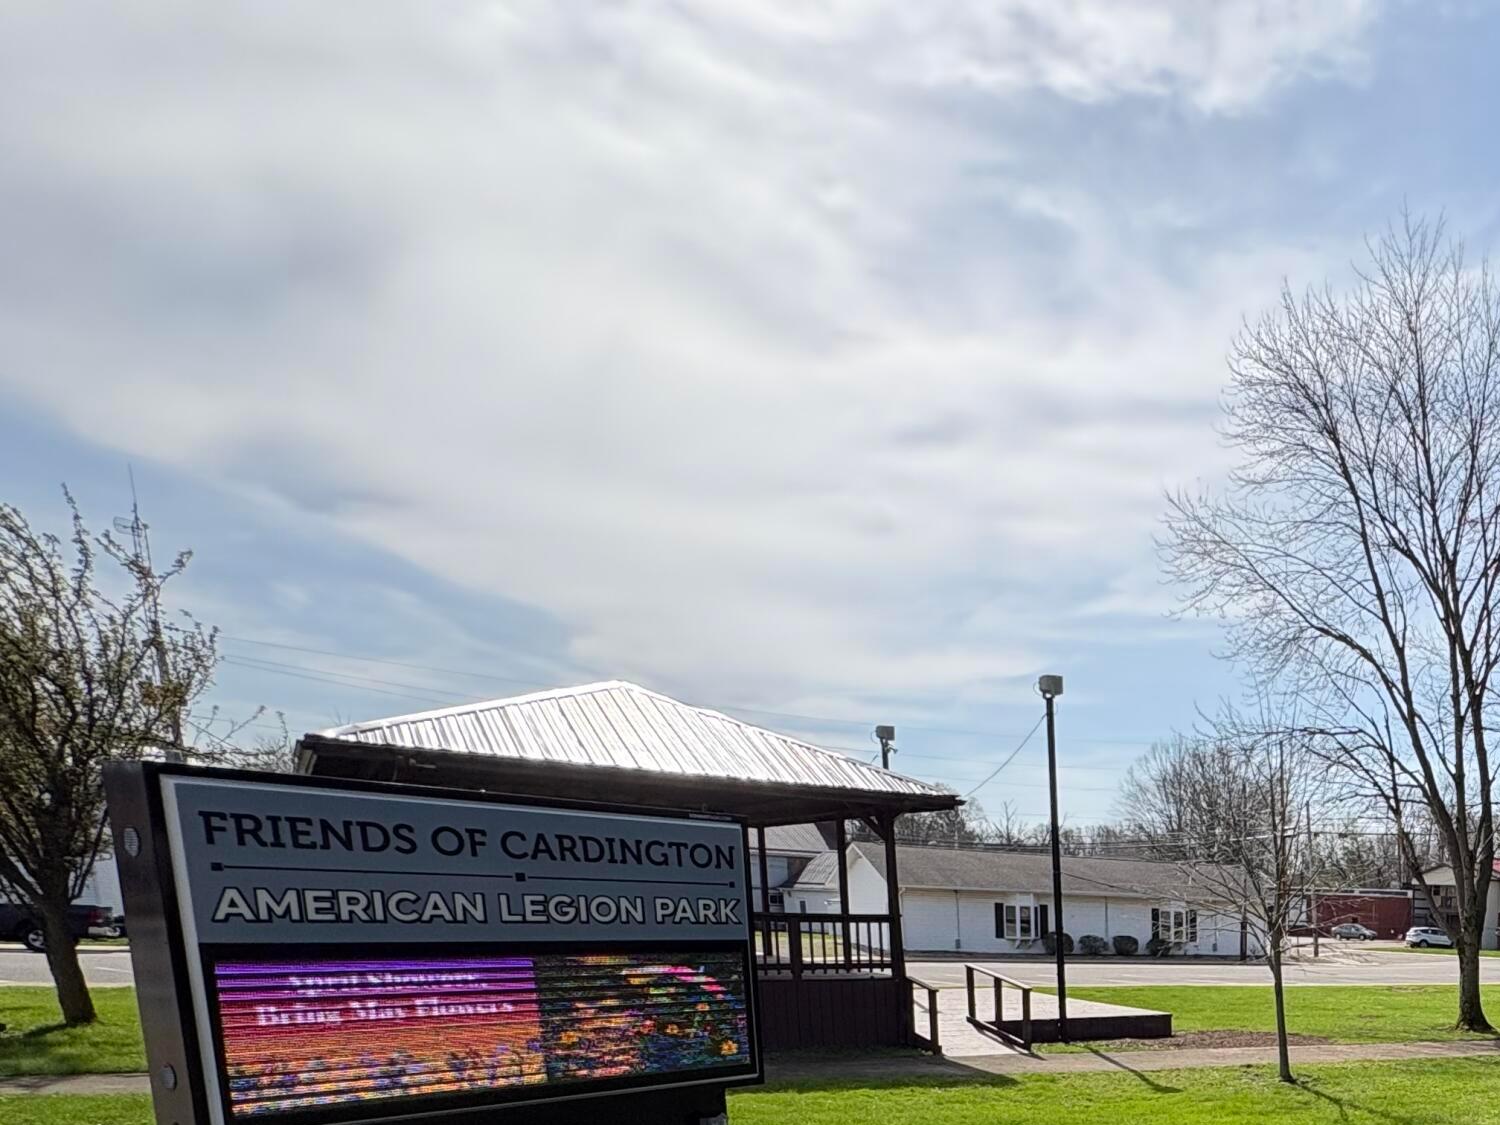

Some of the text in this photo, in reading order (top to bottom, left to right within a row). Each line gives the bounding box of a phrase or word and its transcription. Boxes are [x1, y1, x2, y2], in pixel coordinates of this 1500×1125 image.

[198, 810, 735, 870] FRIENDS OF CARDINGTON
[211, 886, 743, 925] AMERICAN LEGION PARK
